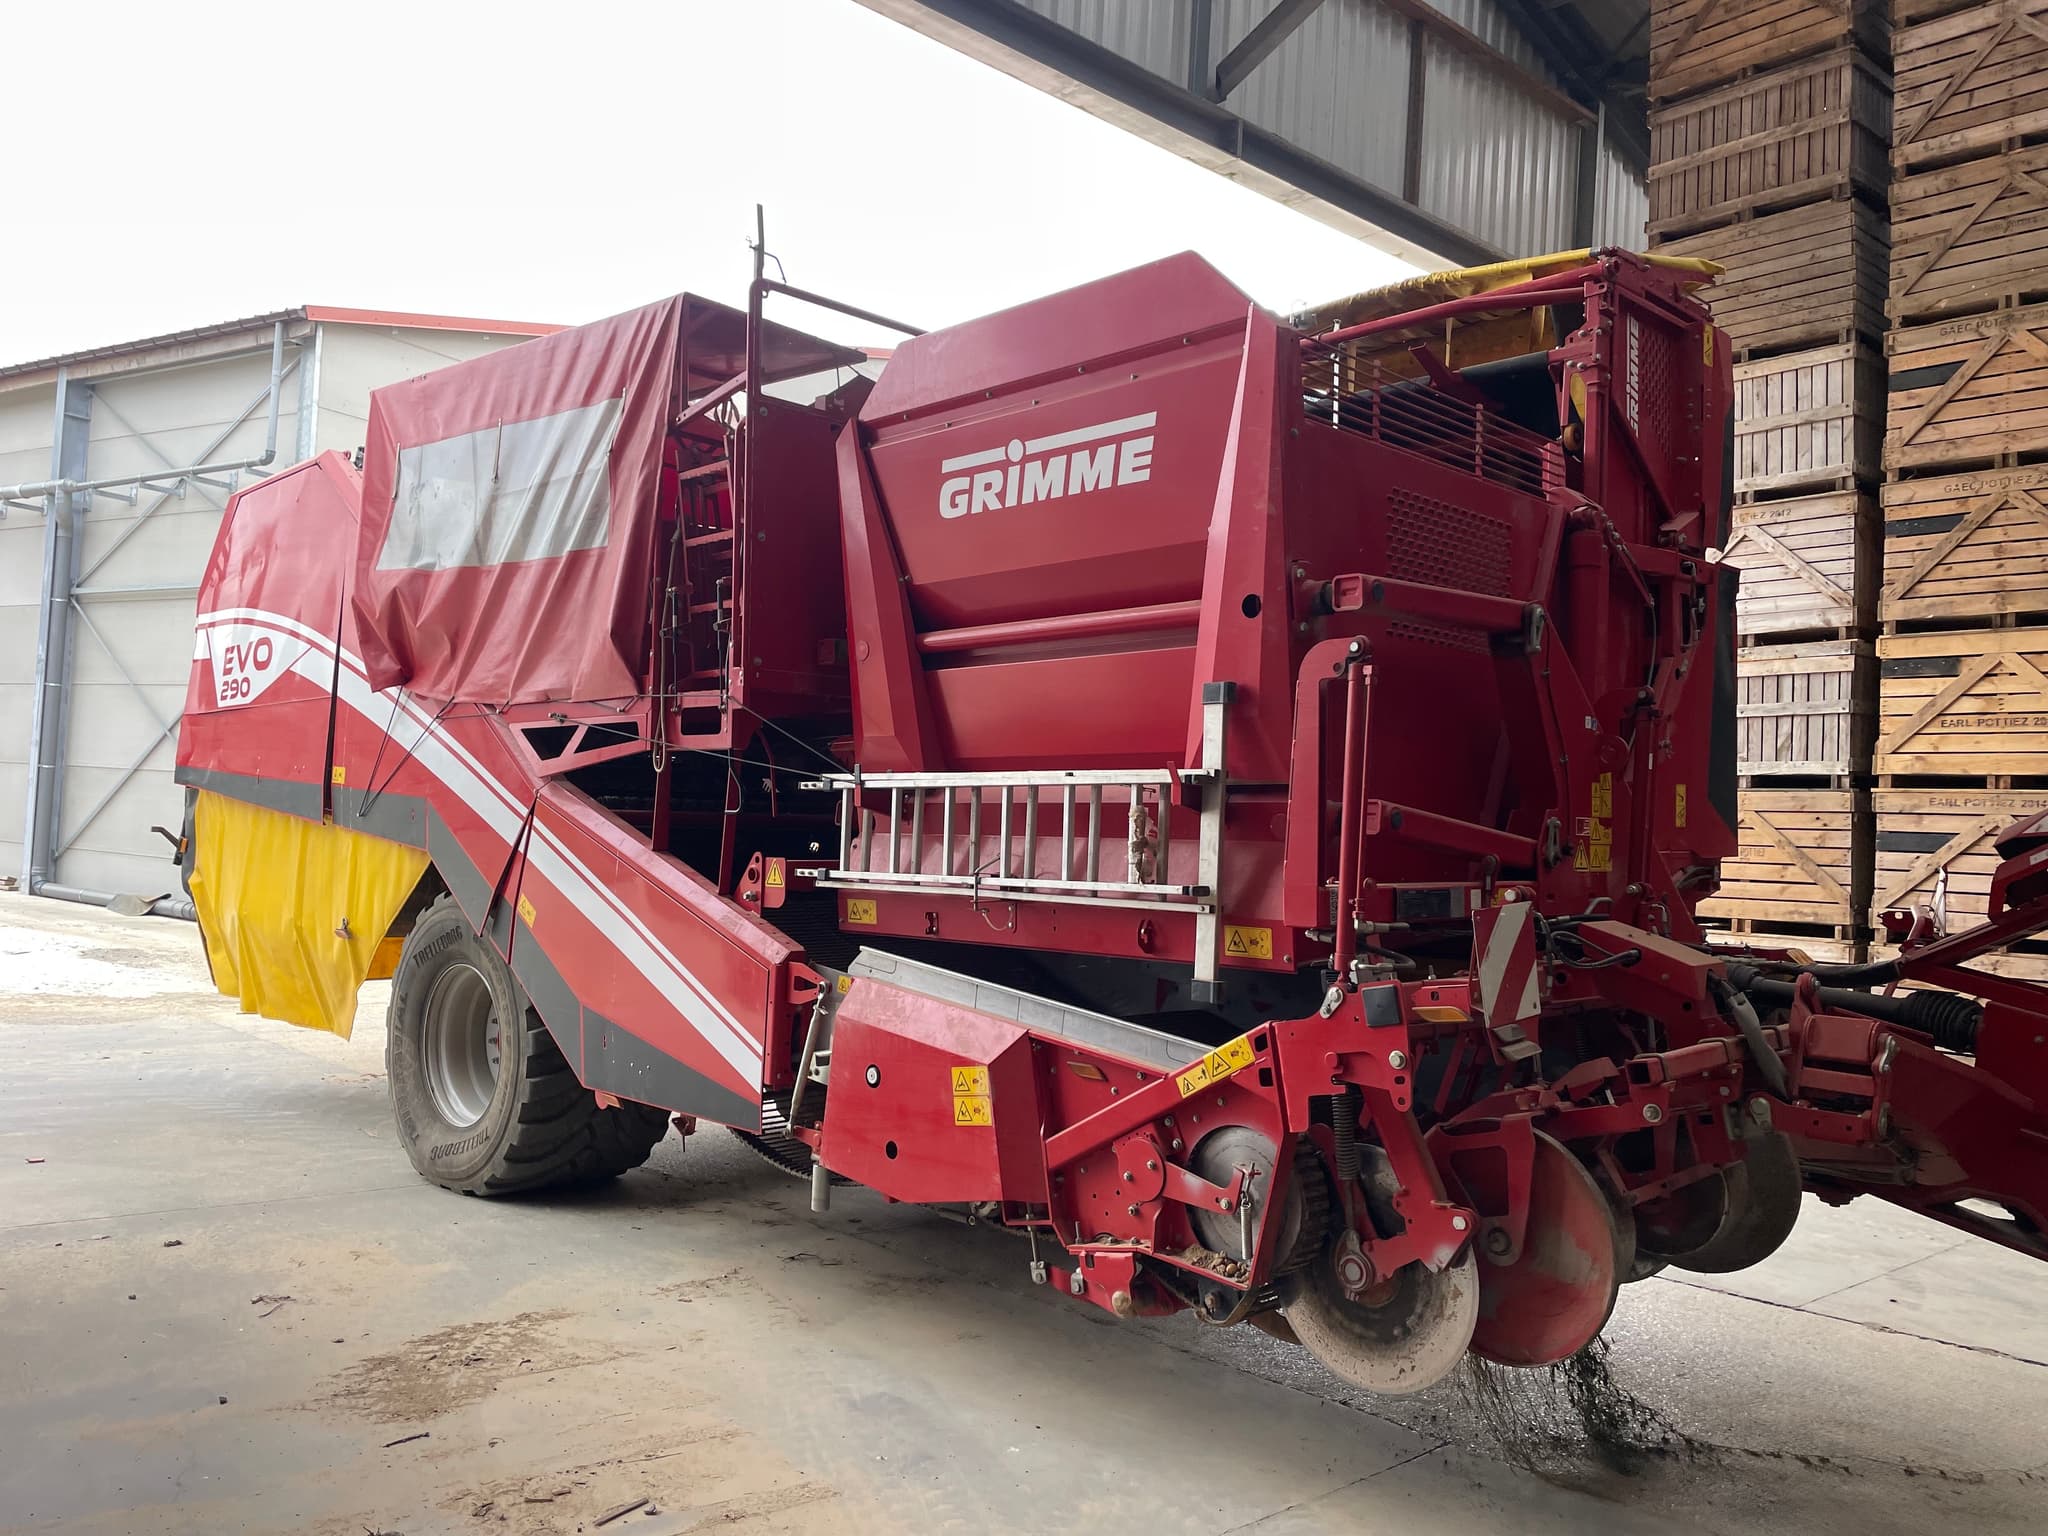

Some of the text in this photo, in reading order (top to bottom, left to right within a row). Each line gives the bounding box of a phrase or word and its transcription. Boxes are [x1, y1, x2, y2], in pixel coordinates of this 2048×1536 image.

[939, 431, 1155, 520] GRIMME
[222, 637, 274, 676] EVO
[220, 677, 251, 701] 290
[1940, 718, 1973, 729] EARL
[1977, 716, 2029, 728] POTTIEZ
[412, 925, 463, 969] TRELLEBORG
[430, 1126, 490, 1161] TRELLEBORG
